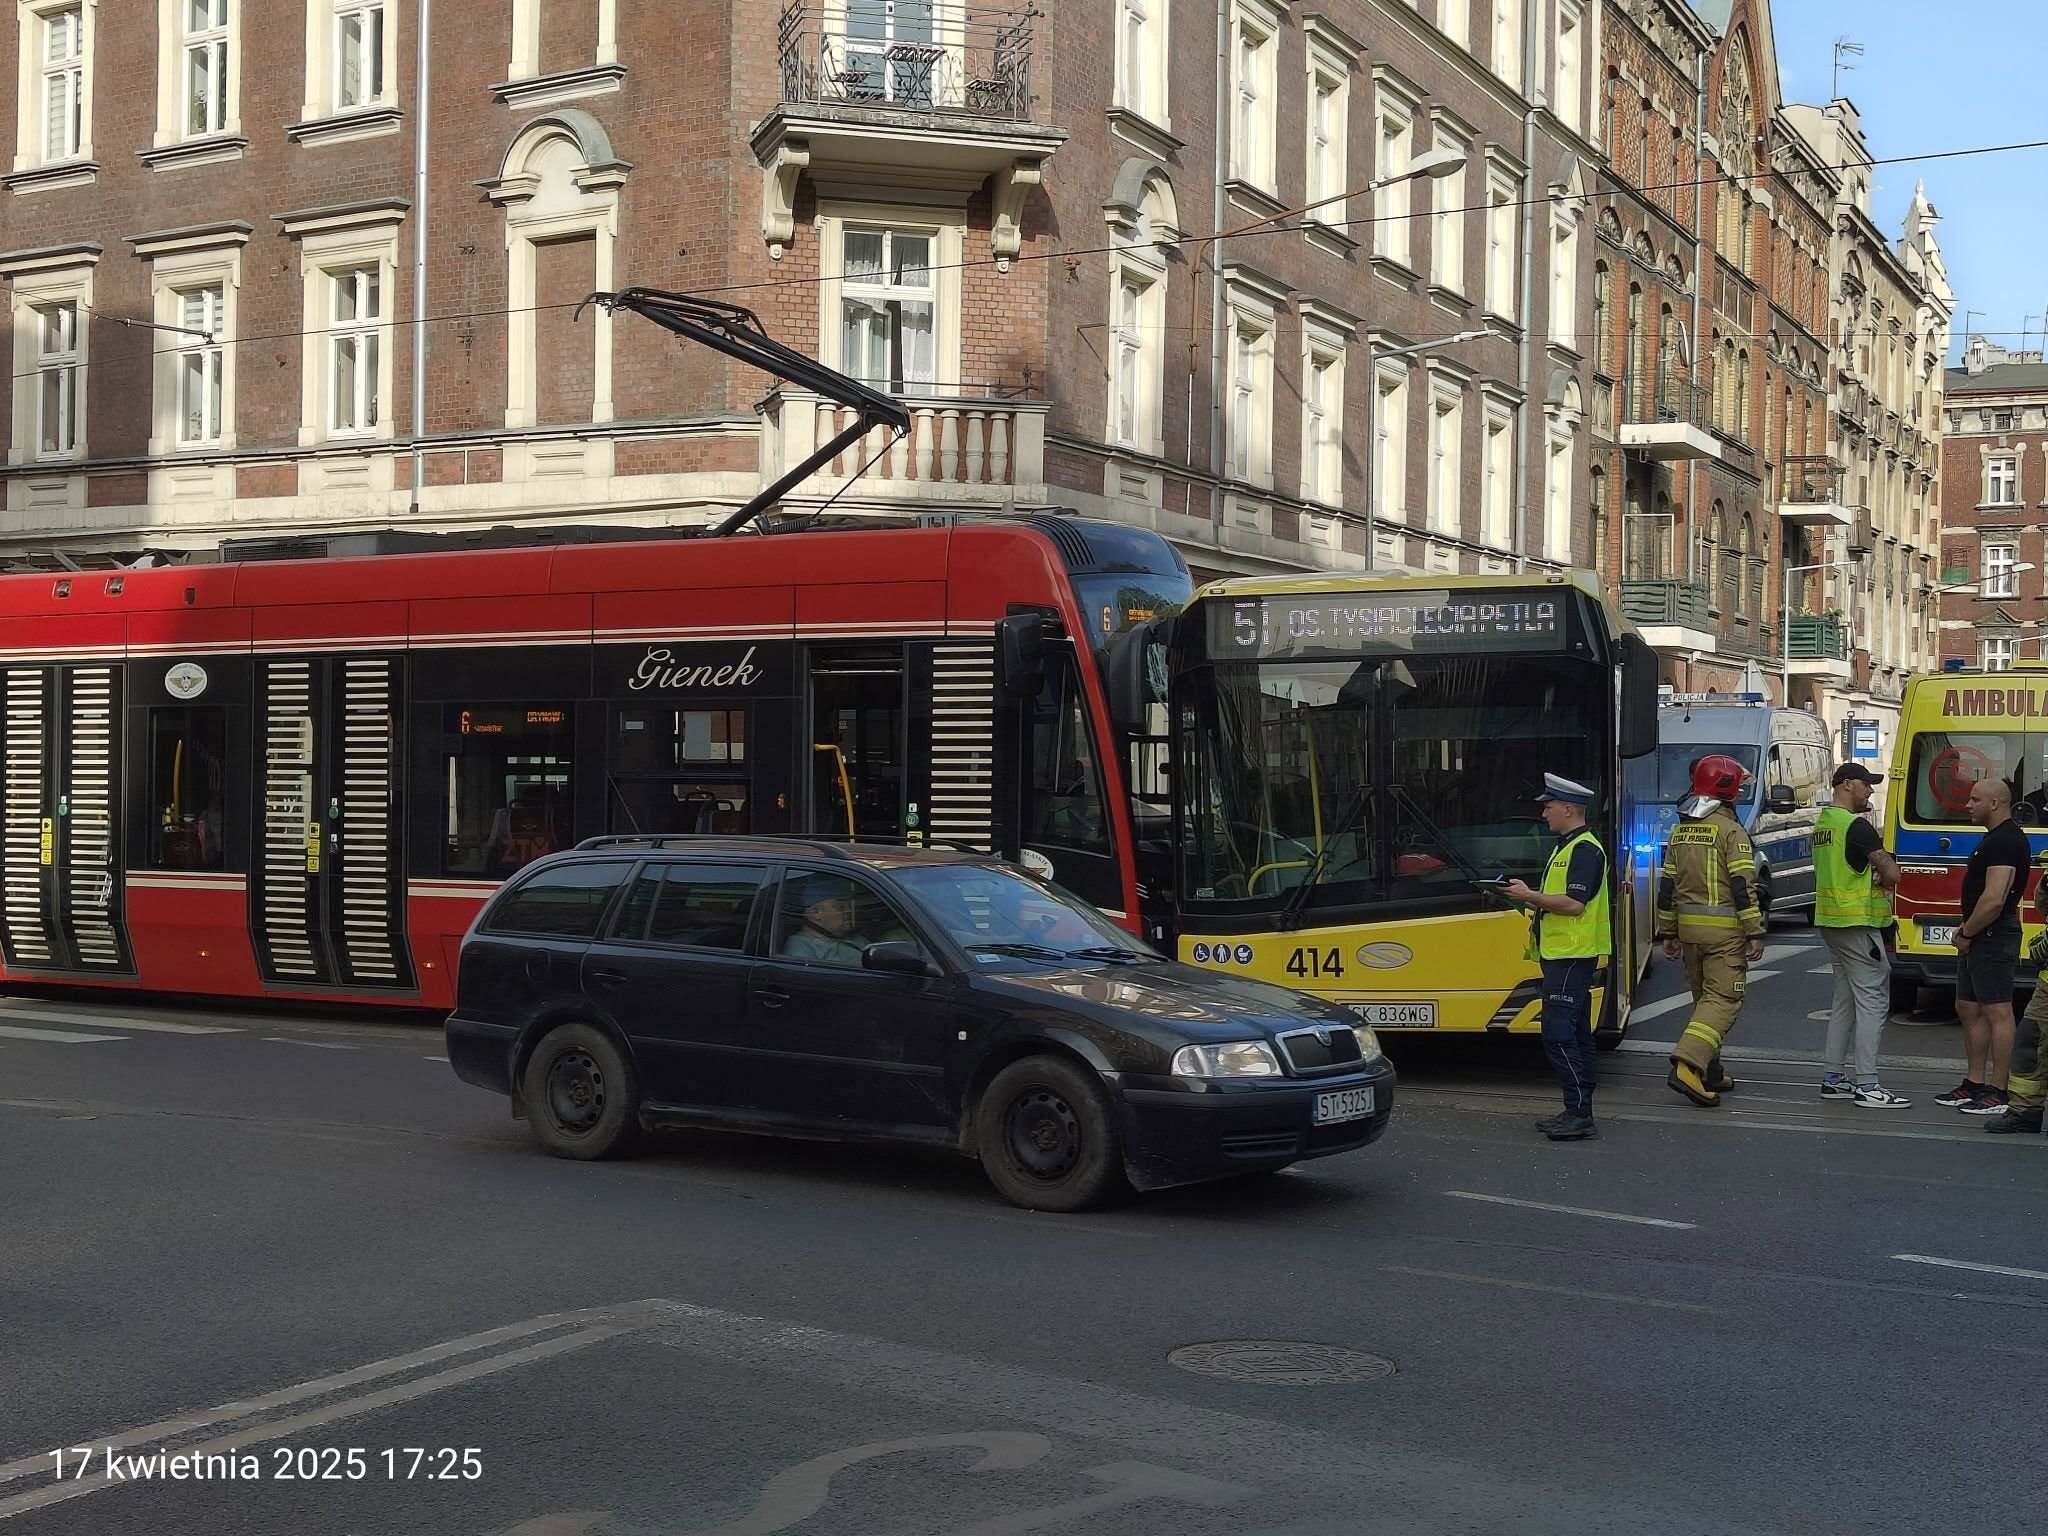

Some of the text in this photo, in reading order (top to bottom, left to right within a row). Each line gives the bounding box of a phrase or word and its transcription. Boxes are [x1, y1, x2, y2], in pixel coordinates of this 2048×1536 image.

[1234, 602, 1270, 645] 51
[628, 645, 763, 690] Gienek
[1673, 693, 1704, 701] POLICJA
[1932, 927, 1951, 942] SK
[1286, 947, 1345, 978] 414
[1379, 1006, 1429, 1022] 836WG
[1320, 1094, 1337, 1117] ST
